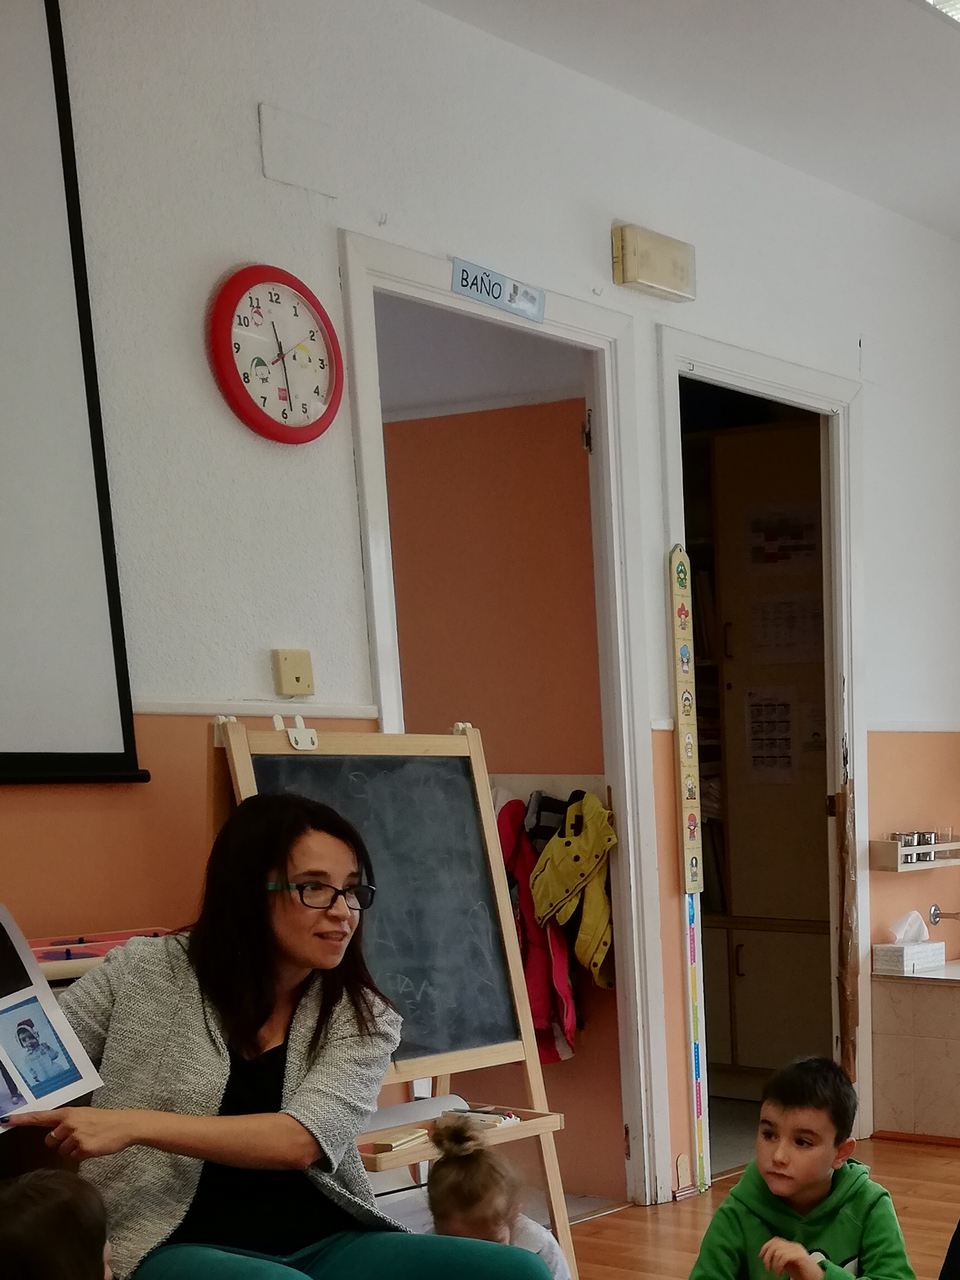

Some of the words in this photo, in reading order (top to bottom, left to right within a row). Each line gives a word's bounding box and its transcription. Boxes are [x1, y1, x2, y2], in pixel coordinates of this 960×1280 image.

[460, 268, 502, 300] BAÑO
[248, 295, 261, 309] 11
[268, 291, 281, 304] 12
[293, 305, 299, 318] 1
[236, 314, 250, 328] 10
[309, 329, 316, 341] 2
[233, 342, 241, 354] 9
[318, 358, 325, 370] 3
[242, 371, 251, 384] 8
[313, 385, 320, 396] 4
[260, 396, 267, 408] 7
[281, 408, 288, 420] 6
[301, 403, 308, 414] 5
